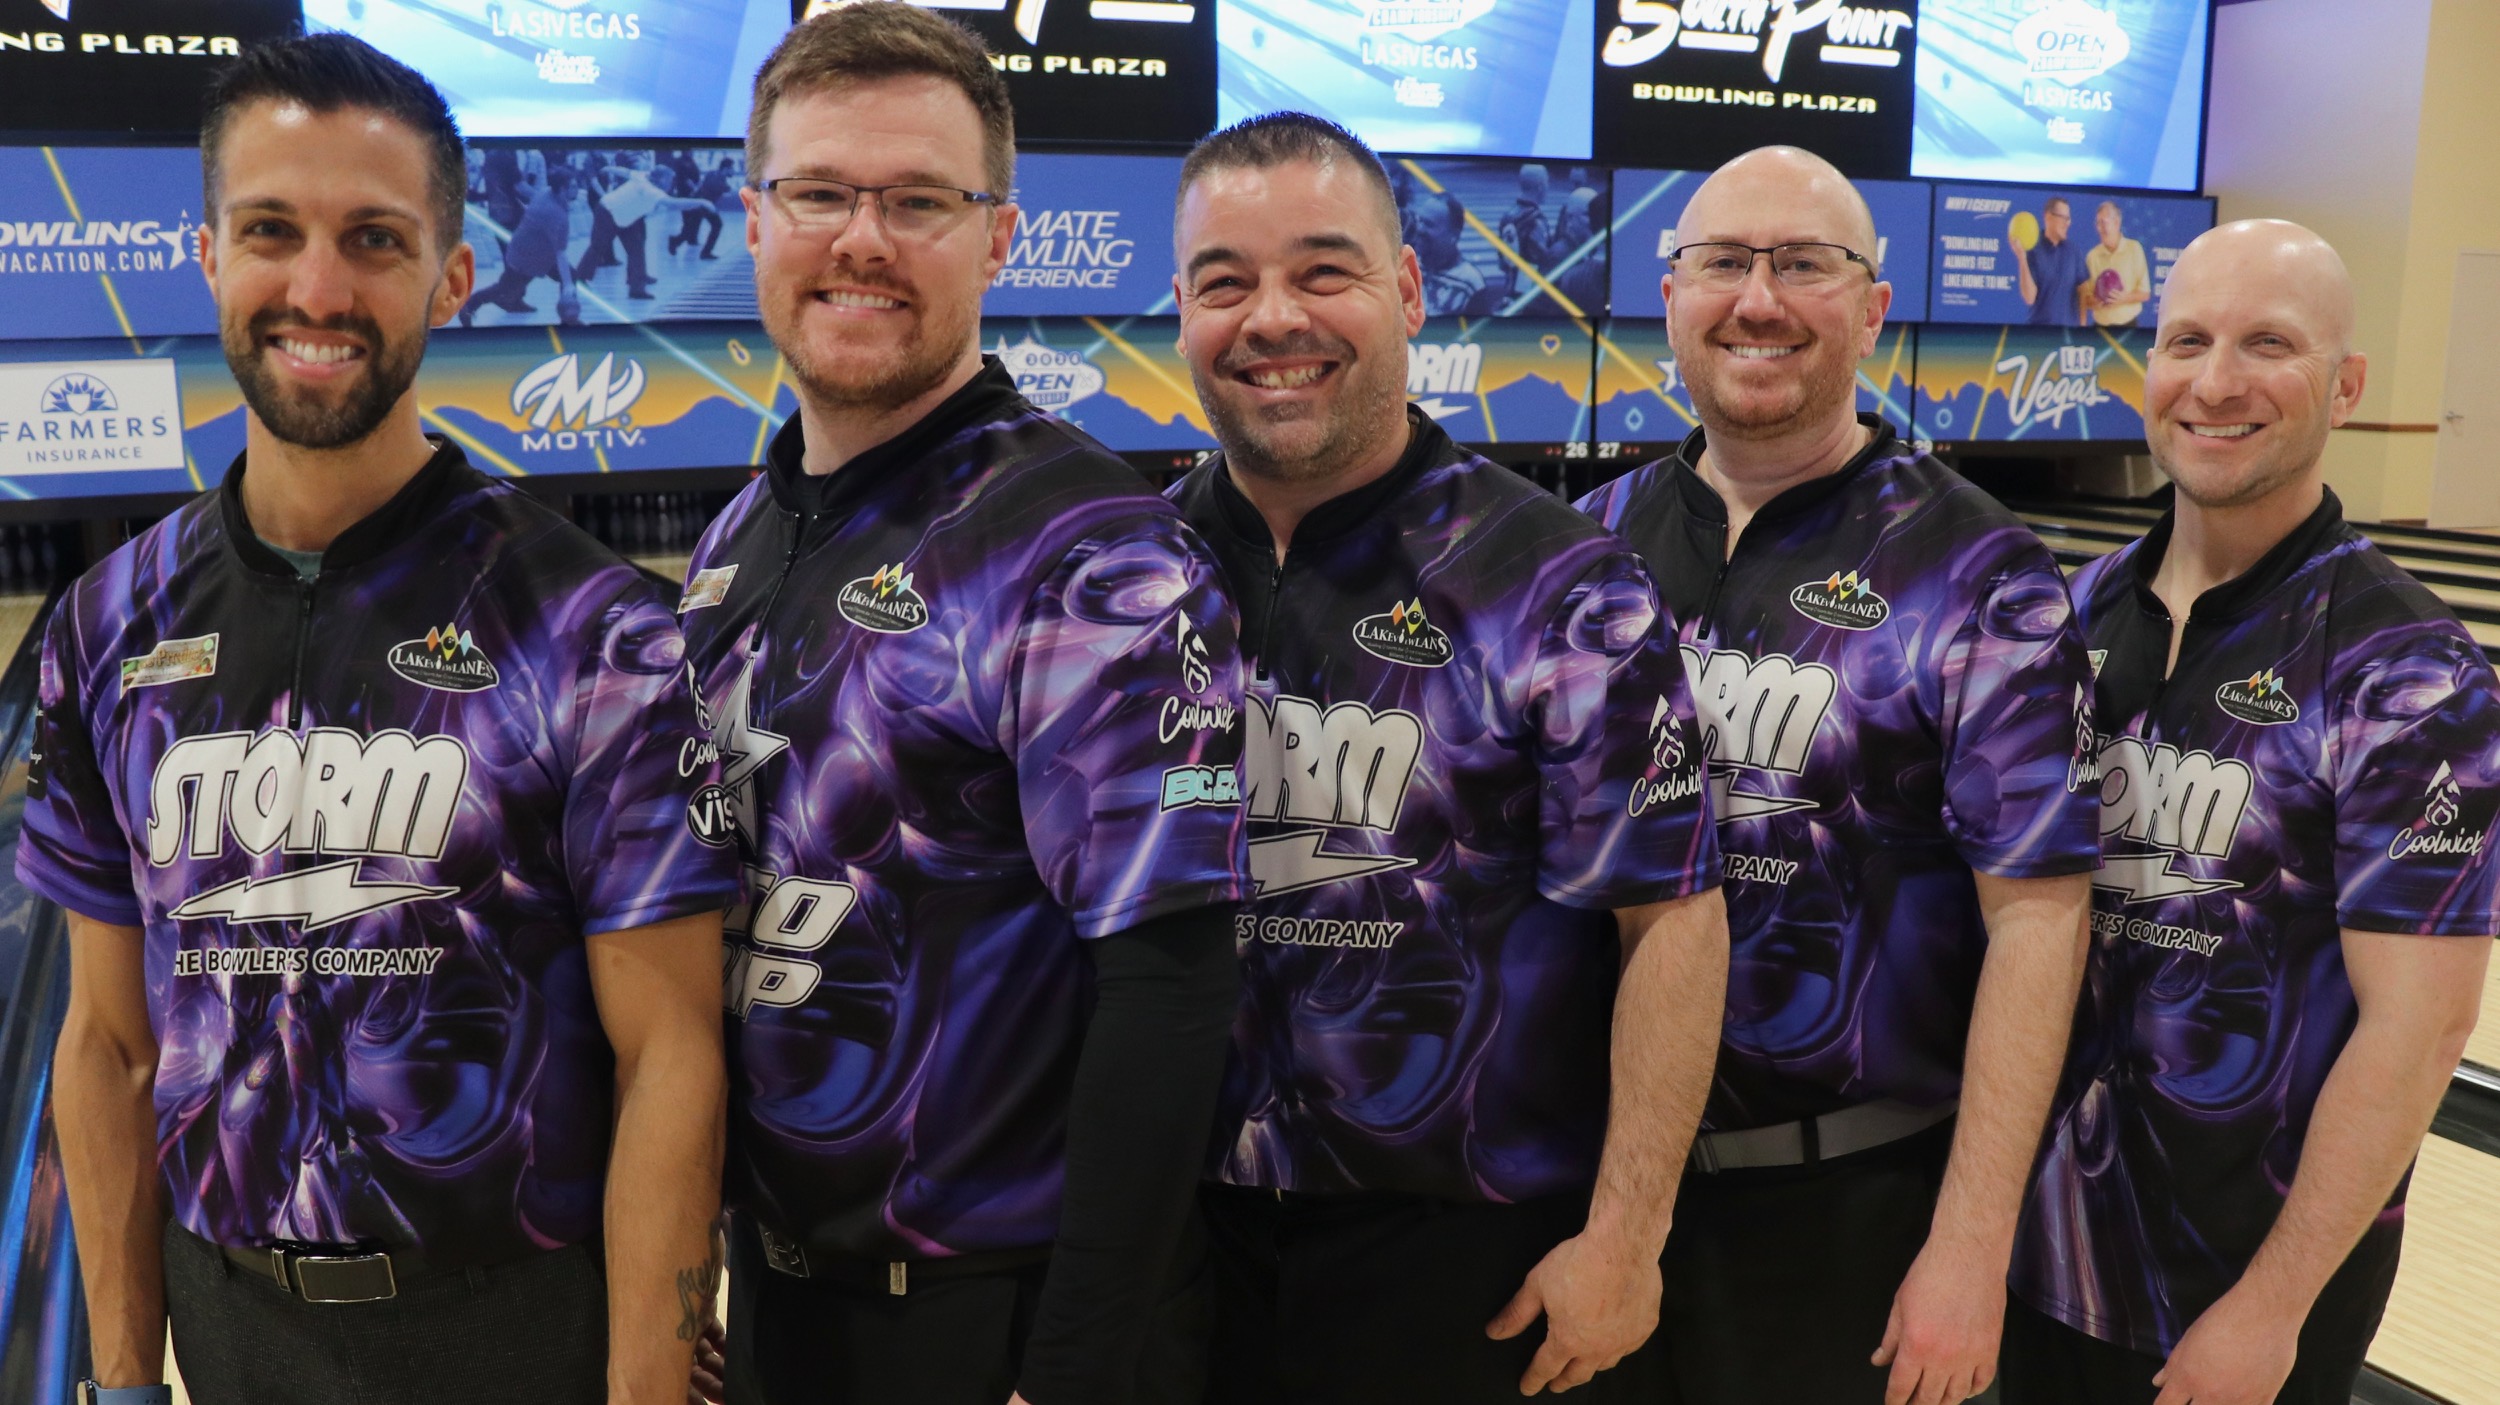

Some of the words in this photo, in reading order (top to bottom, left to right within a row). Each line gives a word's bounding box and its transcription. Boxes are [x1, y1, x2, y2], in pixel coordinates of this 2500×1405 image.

[81, 33, 240, 56] PLAZA
[2036, 30, 2107, 53] OPEN
[1043, 55, 1167, 77] PLAZA
[1632, 83, 1776, 107] BOWLING
[1782, 92, 1878, 114] PLAZA
[2065, 349, 2092, 370] LAS
[1997, 351, 2110, 429] Vegas
[0, 416, 167, 442] FARMERS
[522, 428, 642, 452] MOTIV
[27, 447, 143, 463] INSURANCE
[1566, 443, 1589, 458] 26
[1598, 443, 1620, 458] 27
[1159, 695, 1236, 744] Coolwick
[147, 726, 470, 867] STORM
[2097, 733, 2254, 862] ORM
[2388, 827, 2484, 860] Coolwick
[1260, 917, 1403, 948] COMPANY
[2126, 918, 2222, 957] COMPANY
[207, 948, 308, 976] BOWLER'S
[312, 947, 444, 976] COMPANY
